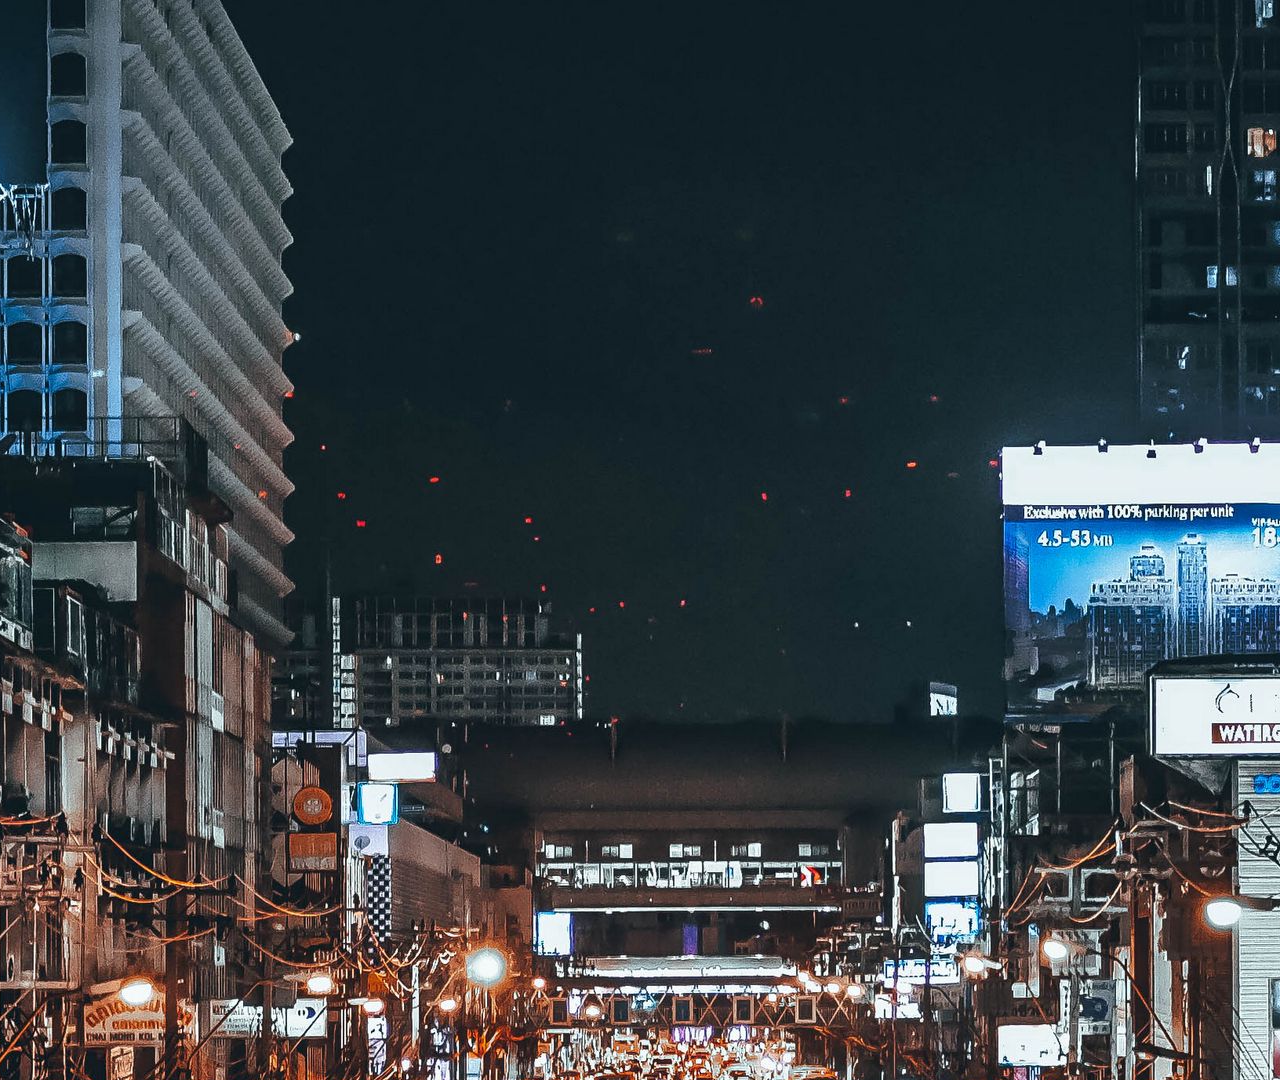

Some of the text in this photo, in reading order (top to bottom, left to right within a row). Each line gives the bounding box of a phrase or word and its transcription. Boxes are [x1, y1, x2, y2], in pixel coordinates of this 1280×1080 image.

[1023, 504, 1234, 521] Exclusive with 100% parking per unit
[1037, 529, 1091, 547] 4.5-53
